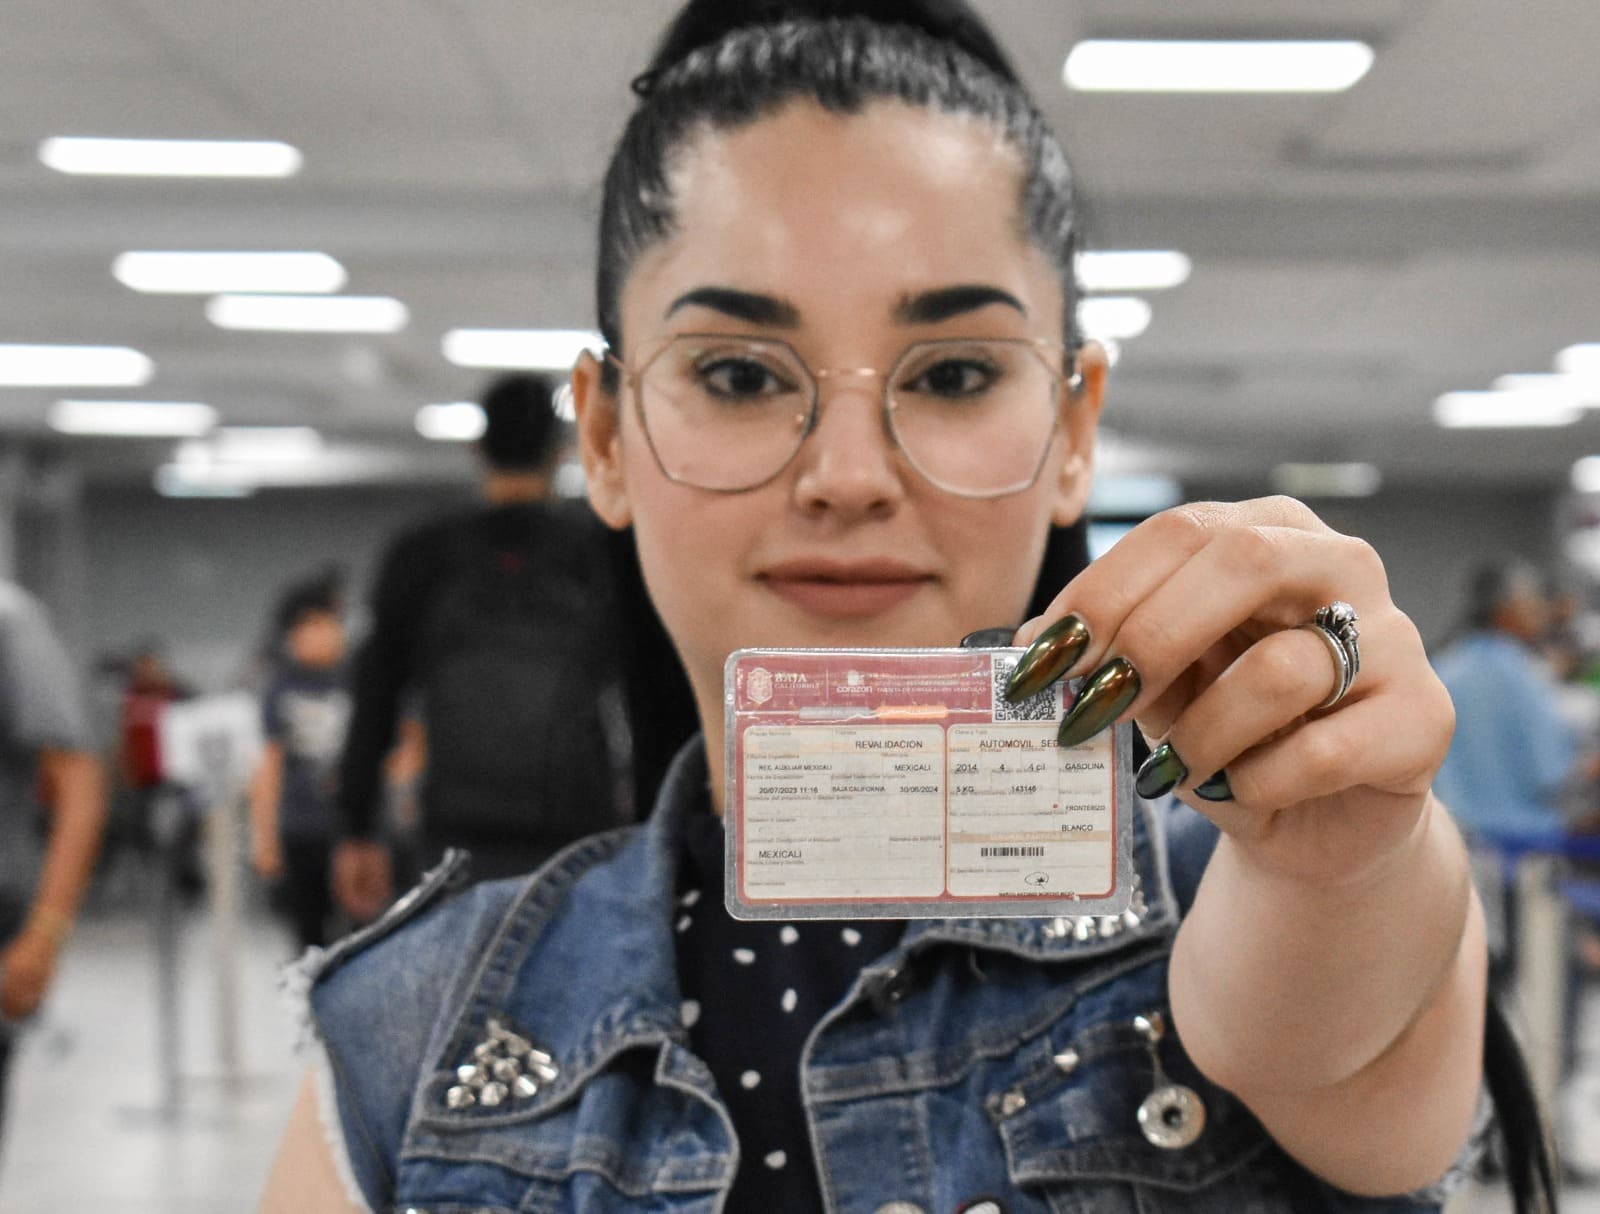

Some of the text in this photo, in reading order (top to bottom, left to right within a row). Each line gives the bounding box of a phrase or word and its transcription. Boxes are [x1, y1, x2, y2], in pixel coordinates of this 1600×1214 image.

[855, 740, 923, 748] REVALIDACION
[980, 740, 1034, 748] AUTOMOVIL
[956, 763, 977, 772] 2014
[758, 850, 802, 859] MEXICALI
